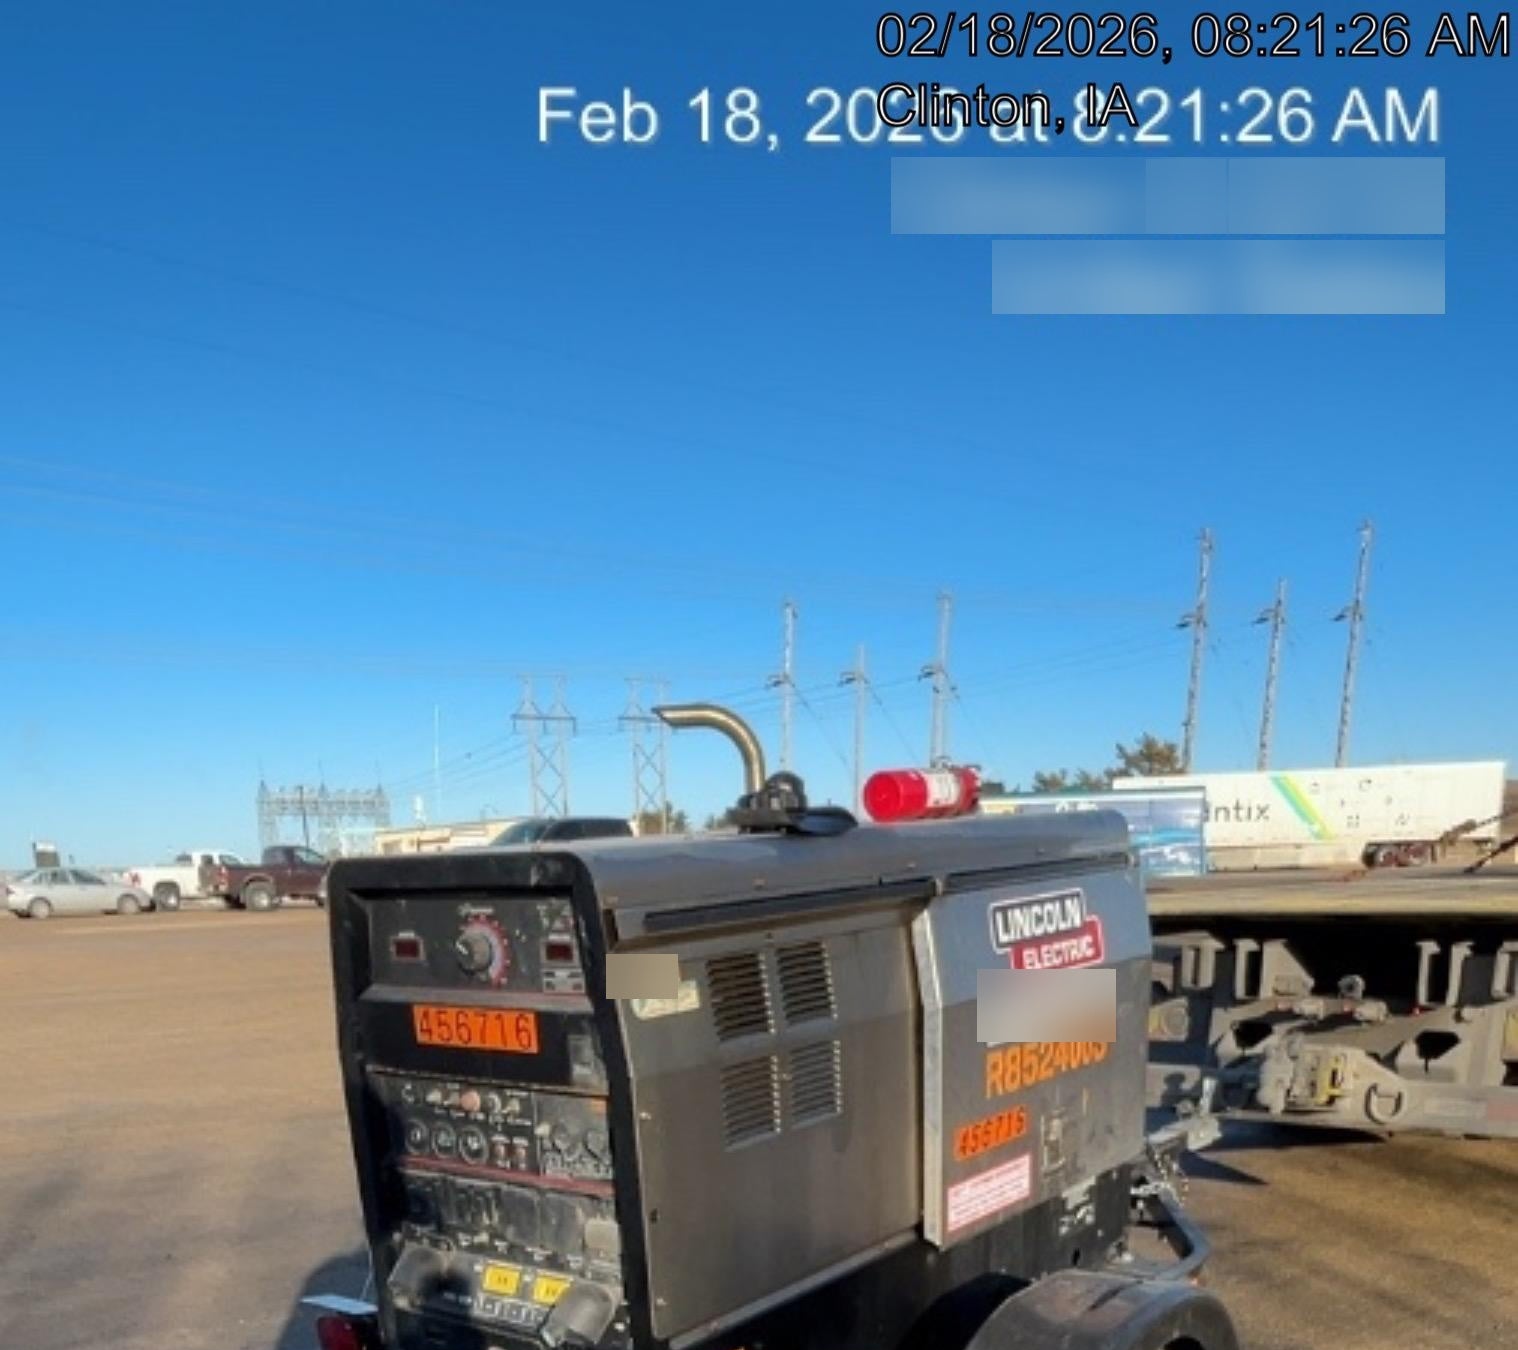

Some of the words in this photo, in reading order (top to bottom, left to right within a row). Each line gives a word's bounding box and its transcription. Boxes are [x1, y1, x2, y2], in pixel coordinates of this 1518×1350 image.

[996, 895, 1081, 944] LINCOLN
[1022, 935, 1095, 970] ELECTRIC
[420, 1008, 531, 1050] 456716
